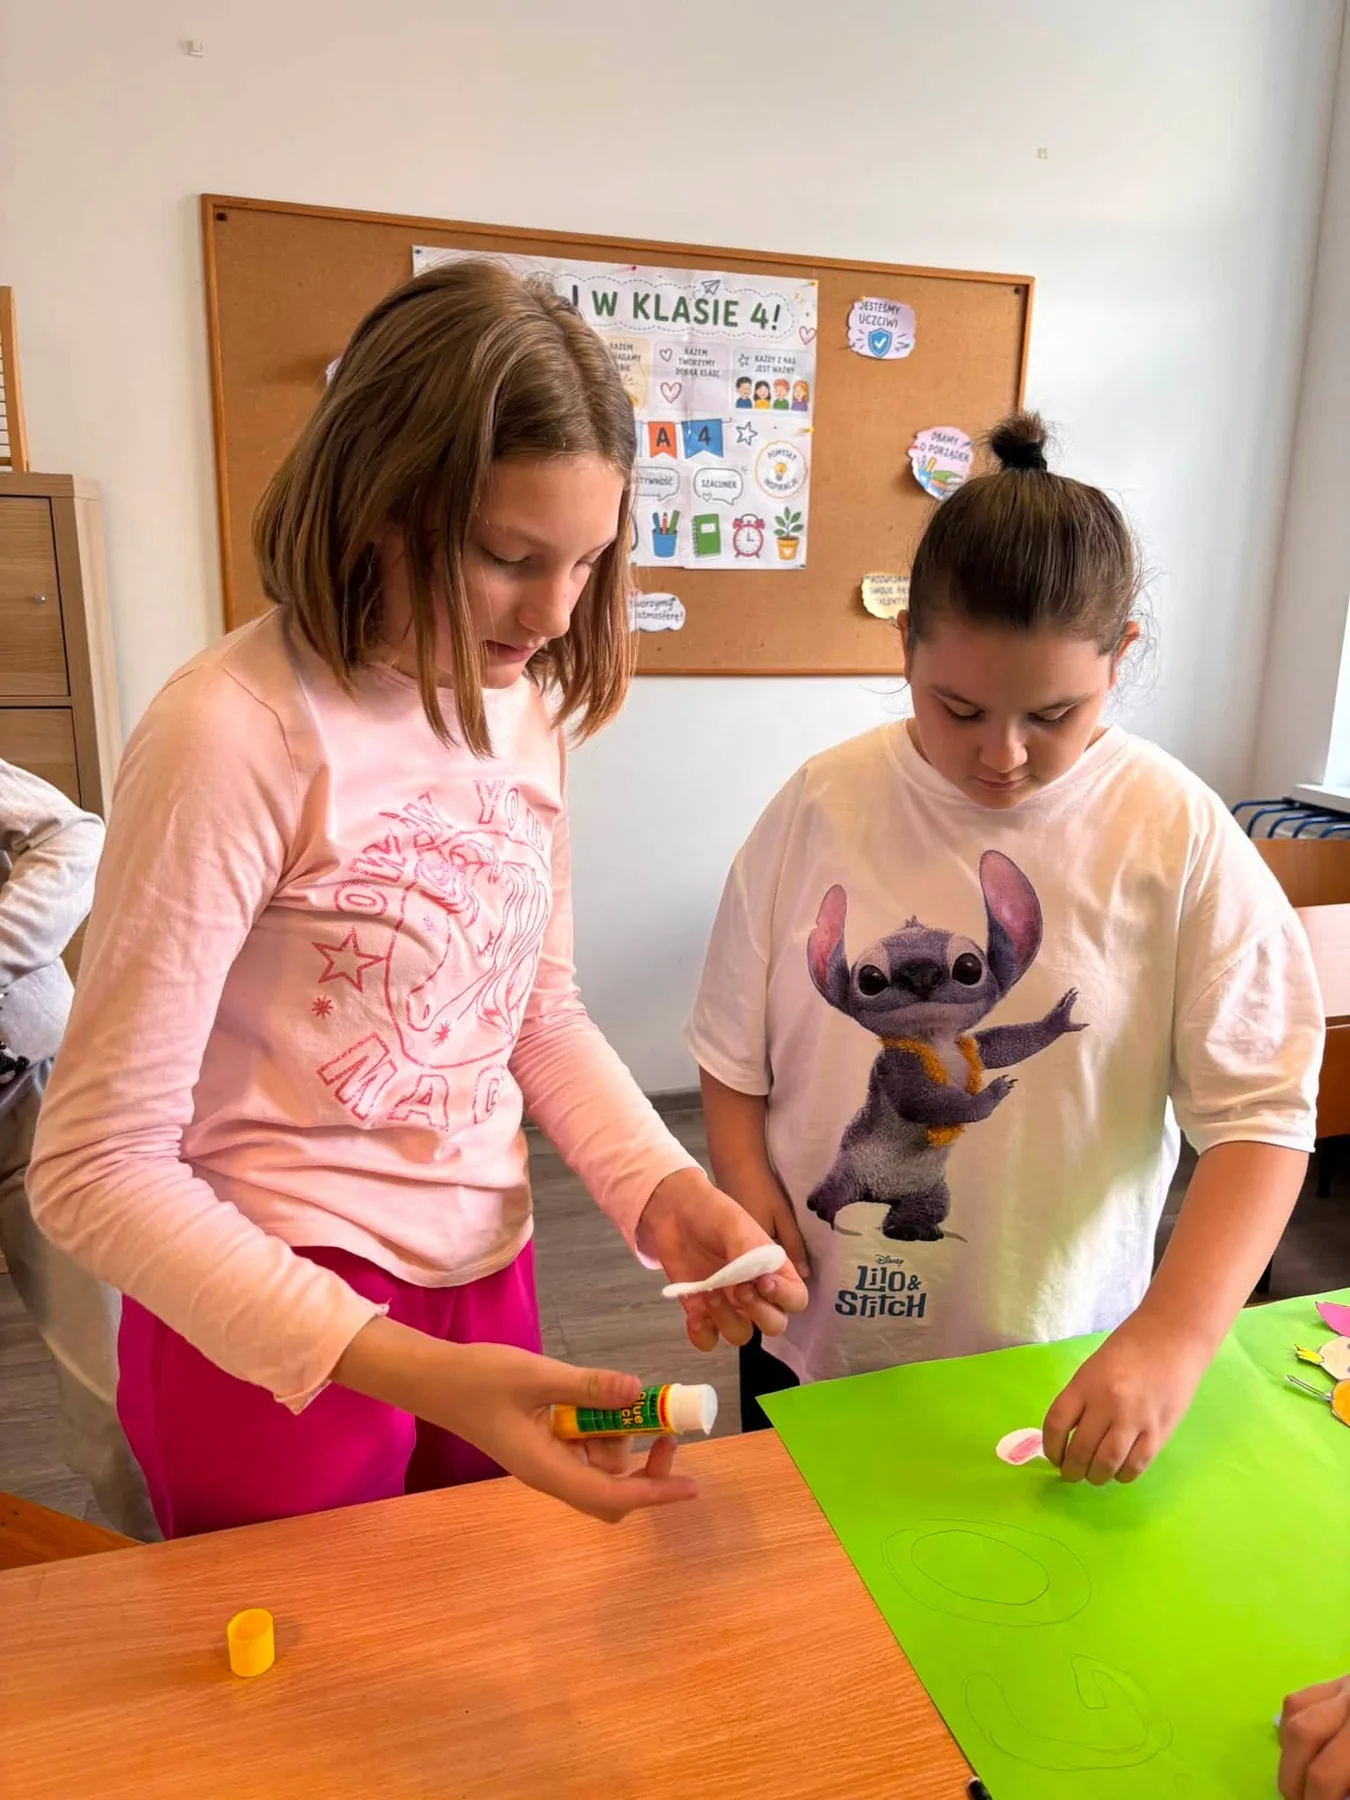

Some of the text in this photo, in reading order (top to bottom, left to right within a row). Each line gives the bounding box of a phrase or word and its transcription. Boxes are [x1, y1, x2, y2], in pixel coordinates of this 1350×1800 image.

[592, 290, 618, 317] W
[632, 291, 739, 328] KLASIE
[750, 302, 781, 331] 4!
[859, 301, 901, 315] JESTEŚMY
[858, 314, 899, 328] UCZCIWI
[684, 347, 708, 356] RAZEM
[697, 425, 711, 447] 4
[928, 444, 970, 462] PORZĄDEK
[701, 479, 738, 489] SZACUNEK
[875, 1253, 905, 1267] Disney
